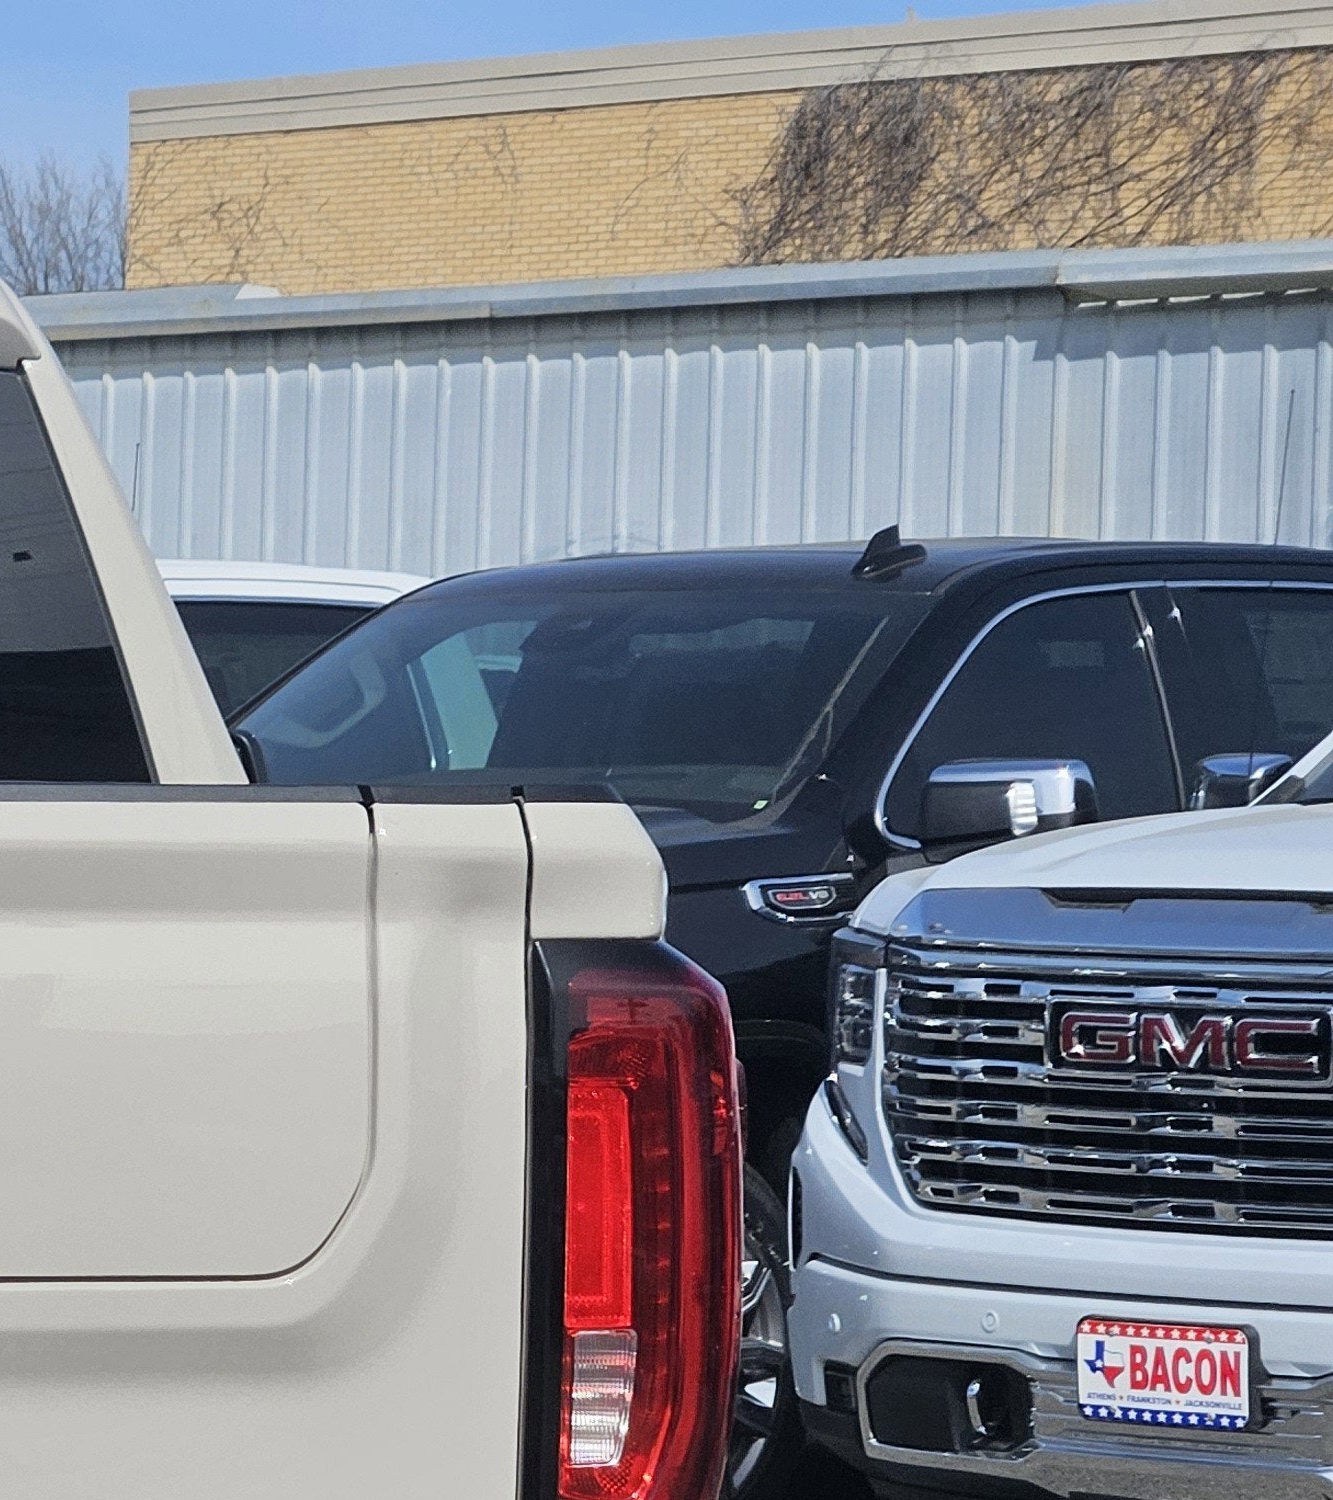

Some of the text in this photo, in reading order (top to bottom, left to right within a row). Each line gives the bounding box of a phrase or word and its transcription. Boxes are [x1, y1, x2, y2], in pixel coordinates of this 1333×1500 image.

[1060, 1011, 1321, 1074] GMC
[1129, 1343, 1242, 1398] BACON
[1086, 1391, 1243, 1411] ATHENS FRANKSTON JACKSONVILLE
